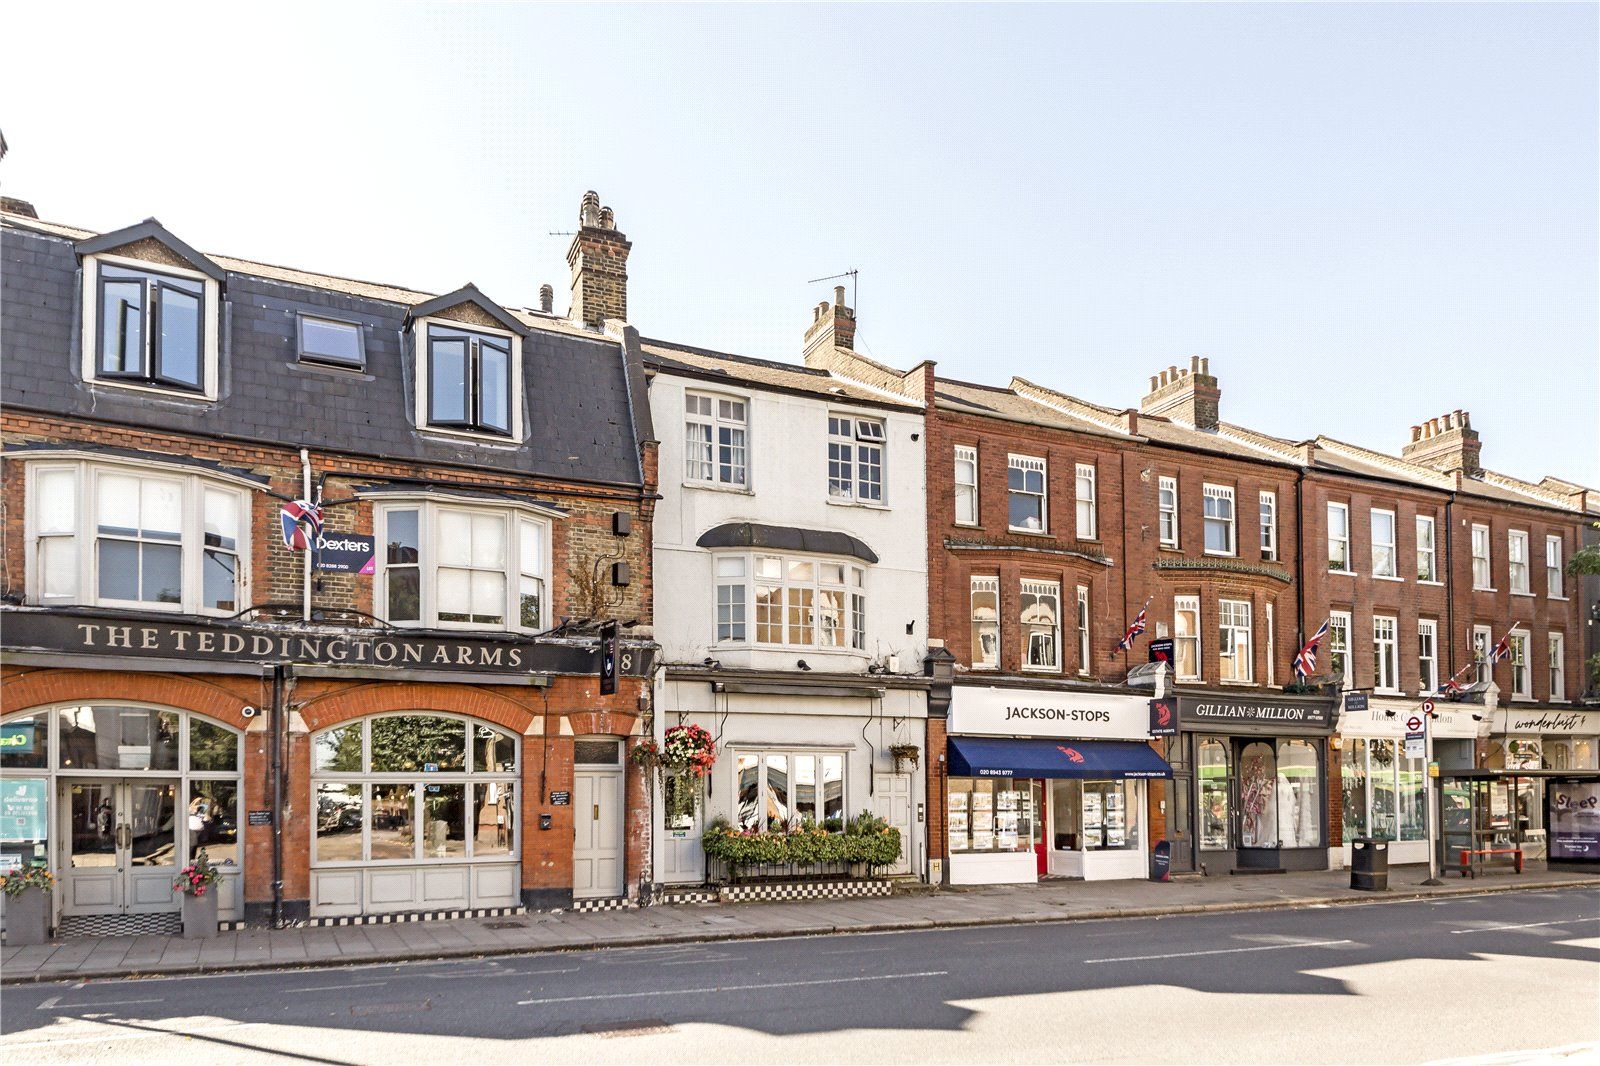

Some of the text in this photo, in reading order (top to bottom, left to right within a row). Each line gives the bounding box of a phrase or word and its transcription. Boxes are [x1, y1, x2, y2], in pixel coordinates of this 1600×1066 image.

[316, 536, 370, 552] Dexters
[77, 623, 521, 667] THE TEDDINGTON ARMS
[621, 653, 632, 670] 8
[1005, 706, 1110, 722] JACKSON-STOPS
[1196, 704, 1304, 720] GILLIAN MILLION
[1423, 702, 1432, 714] D
